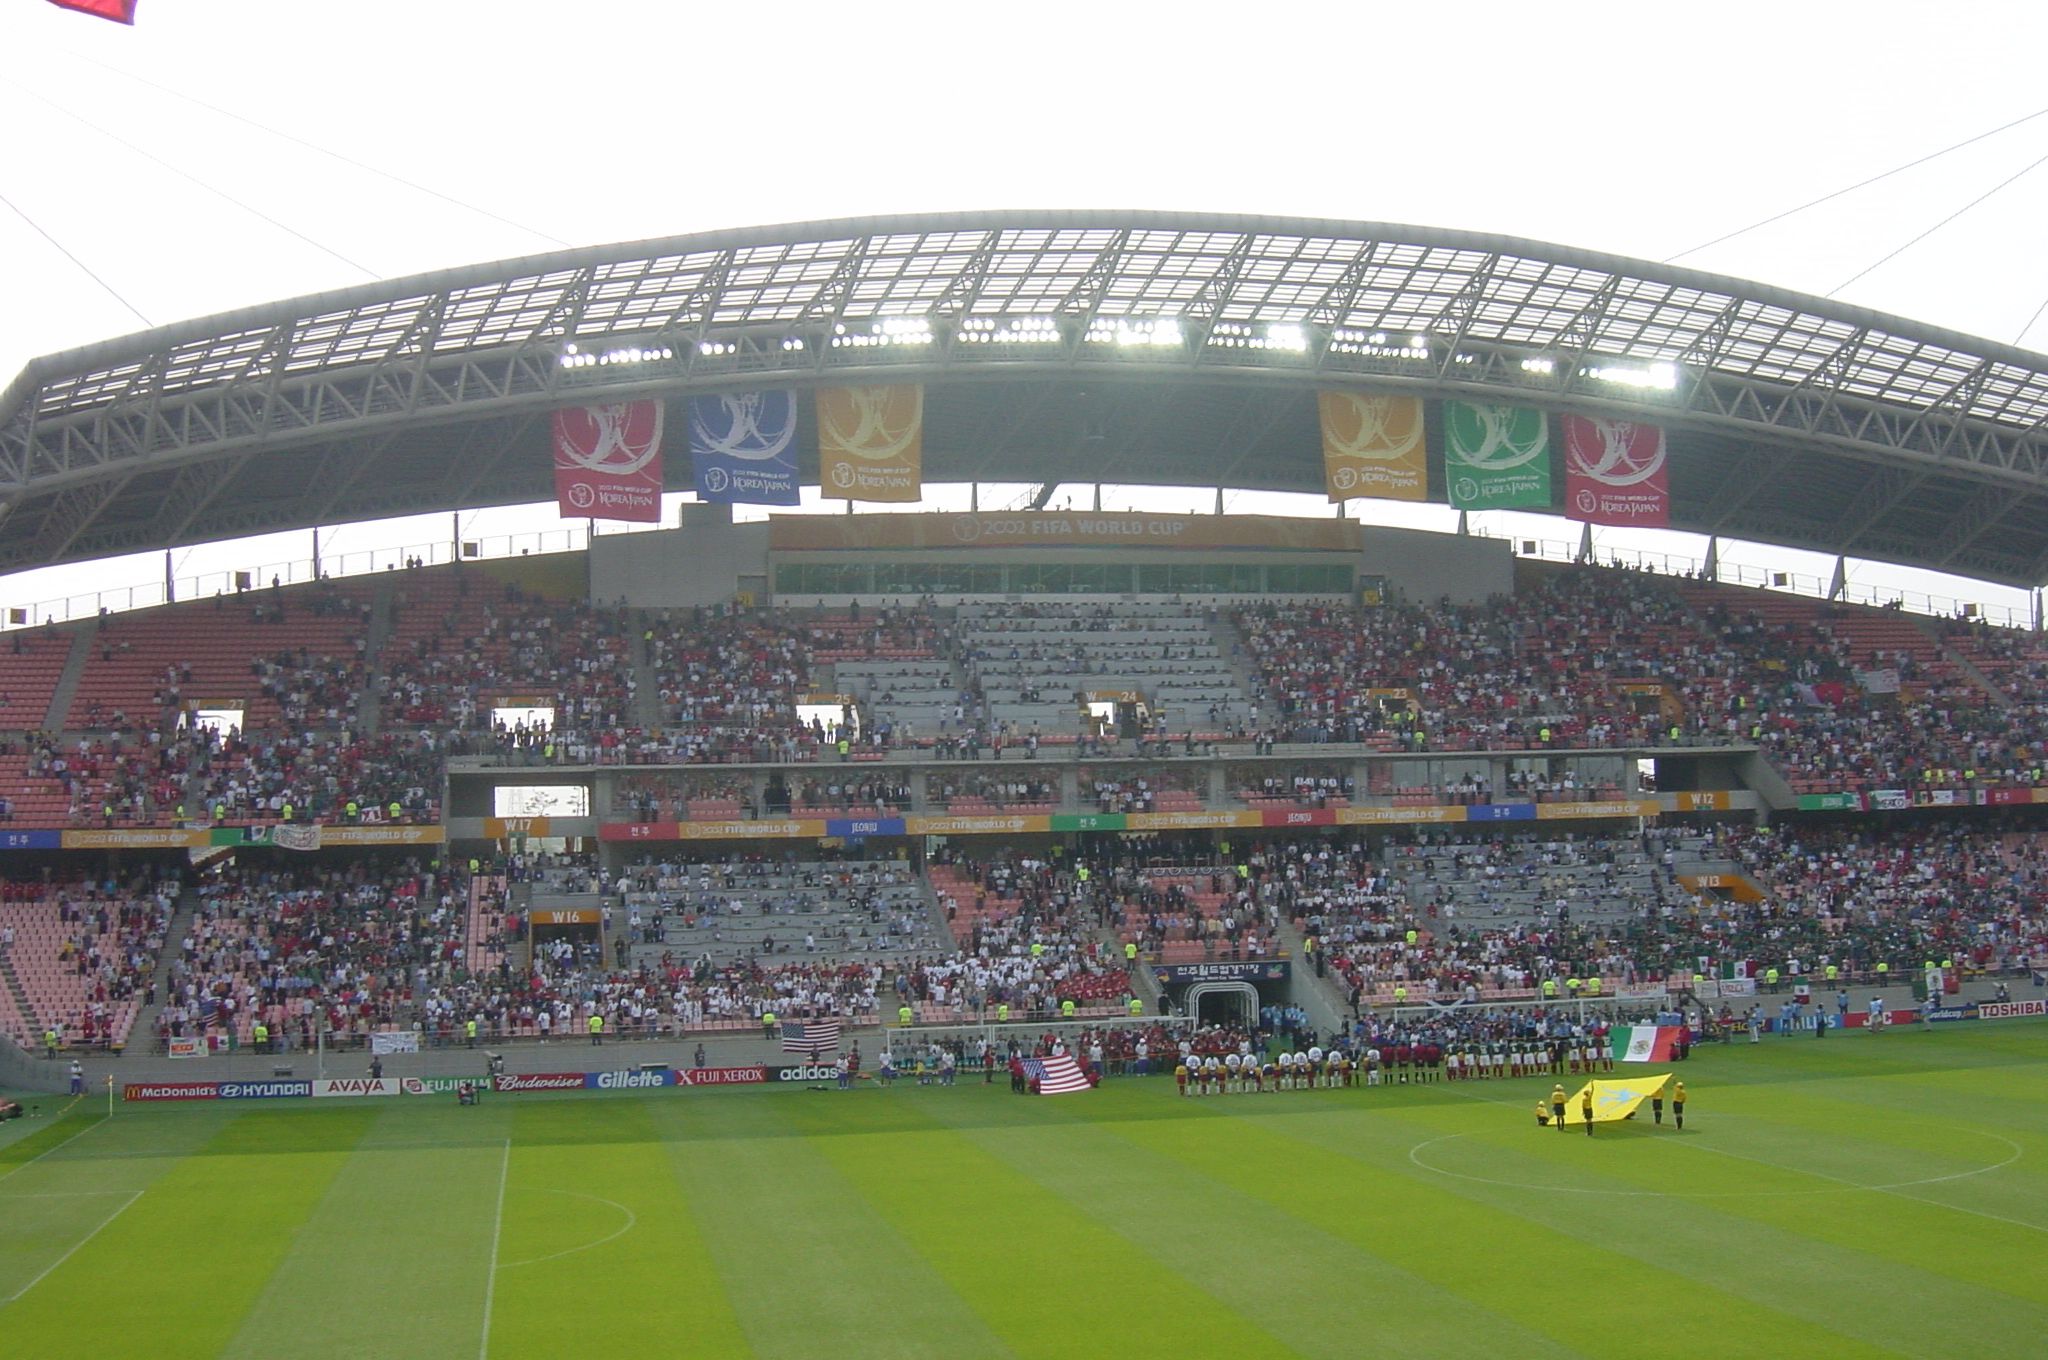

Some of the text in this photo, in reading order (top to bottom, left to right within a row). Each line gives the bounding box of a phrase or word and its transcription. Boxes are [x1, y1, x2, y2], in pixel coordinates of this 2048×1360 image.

[733, 476, 791, 494] KOREA JAPAN
[1481, 481, 1540, 498] KOREA JAPAN
[600, 492, 653, 510] KOREA JAPAN
[1601, 500, 1660, 517] KOREA JAPAN
[984, 519, 1185, 535] 2002 FIFA WORLD CUP
[834, 694, 851, 704] 25
[1086, 691, 1136, 702] W 24
[1981, 1002, 2044, 1017] TOSHIBA
[1862, 1011, 1893, 1026] JC
[597, 1071, 663, 1088] Gillette
[696, 1071, 720, 1083] FUJI
[723, 1069, 763, 1082] XEROX
[780, 1065, 839, 1081] adidas
[243, 1083, 310, 1096] HYUNDAI
[328, 1079, 384, 1095] AVAYA
[497, 1073, 583, 1091] Budweiser
[141, 1086, 217, 1098] McDonald's
